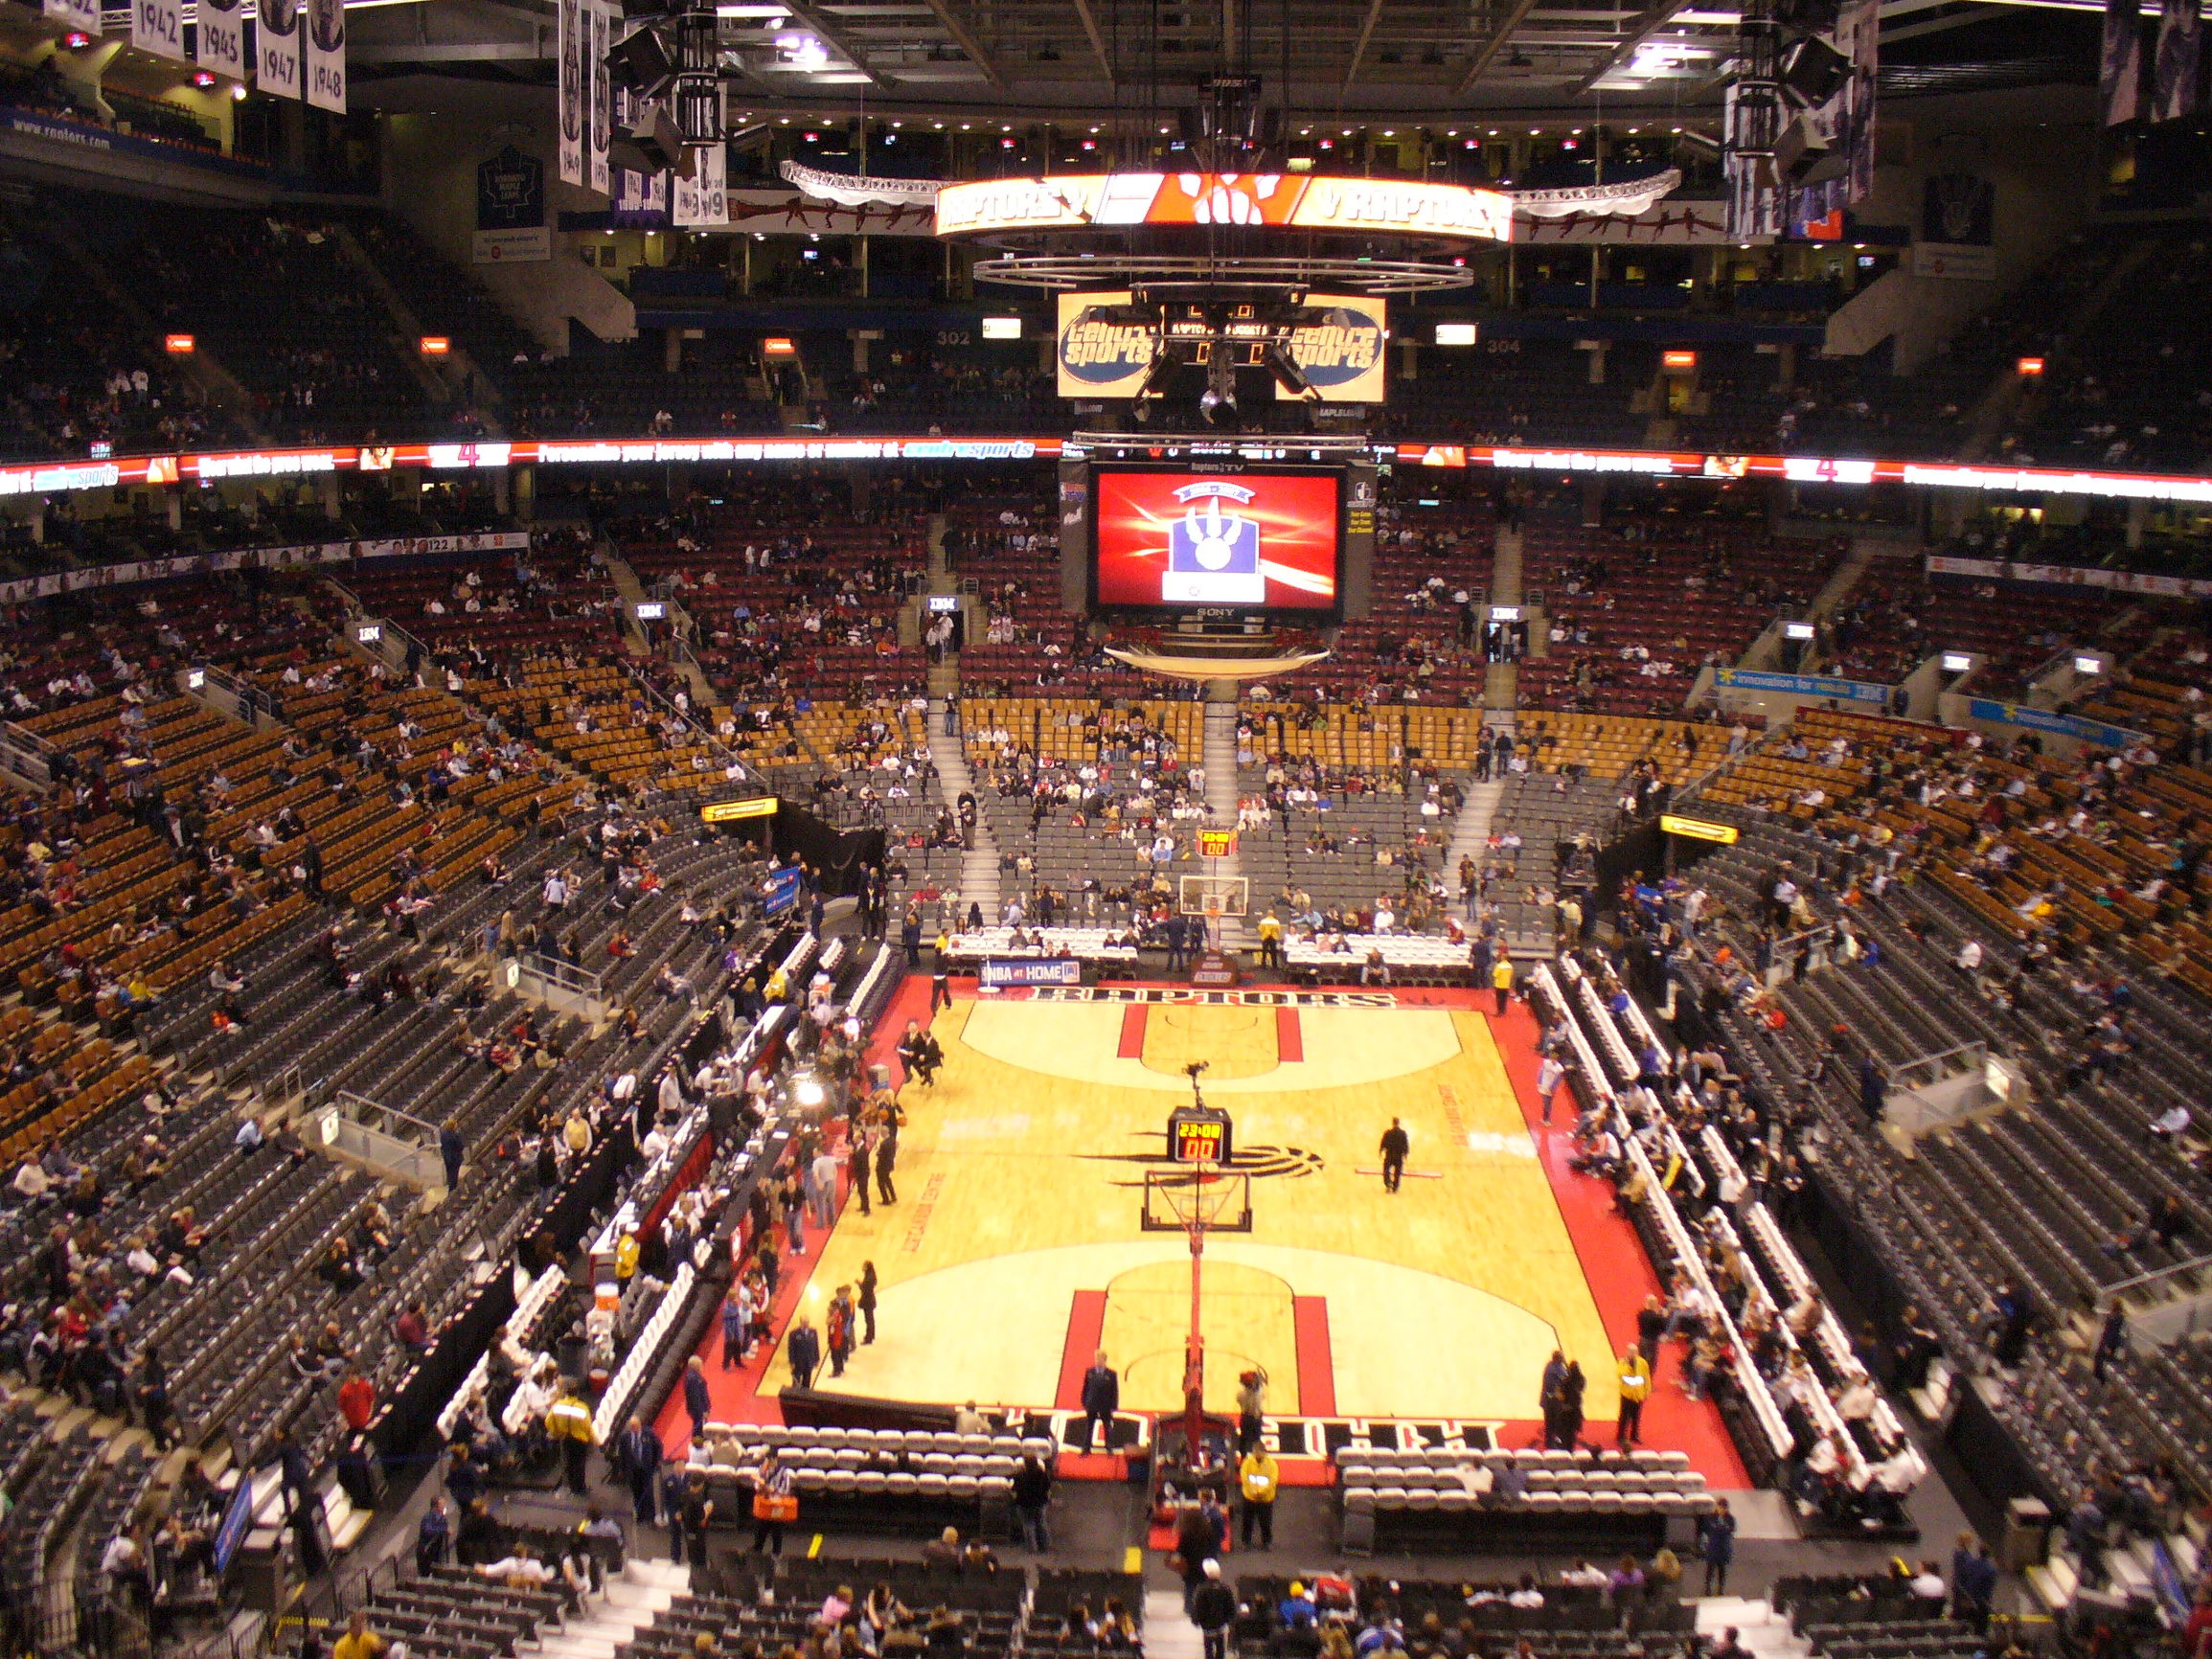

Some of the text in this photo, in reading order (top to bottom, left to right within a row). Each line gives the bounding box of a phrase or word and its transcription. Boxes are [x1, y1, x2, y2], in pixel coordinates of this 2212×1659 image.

[140, 2, 178, 44] 1942
[262, 47, 295, 84] 1947
[313, 64, 341, 98] 1948
[1064, 339, 1153, 364] sports
[458, 443, 480, 466] 4
[77, 464, 119, 489] sports
[1816, 459, 1838, 482] 4
[1197, 607, 1236, 618] SONY
[358, 626, 380, 642] IBM
[1796, 678, 1813, 690] for
[1207, 843, 1226, 855] 00
[989, 966, 1012, 981] NBA
[1026, 966, 1062, 981] HOME
[1027, 985, 1399, 1009] RAPTORS
[1184, 1138, 1215, 1159] 00
